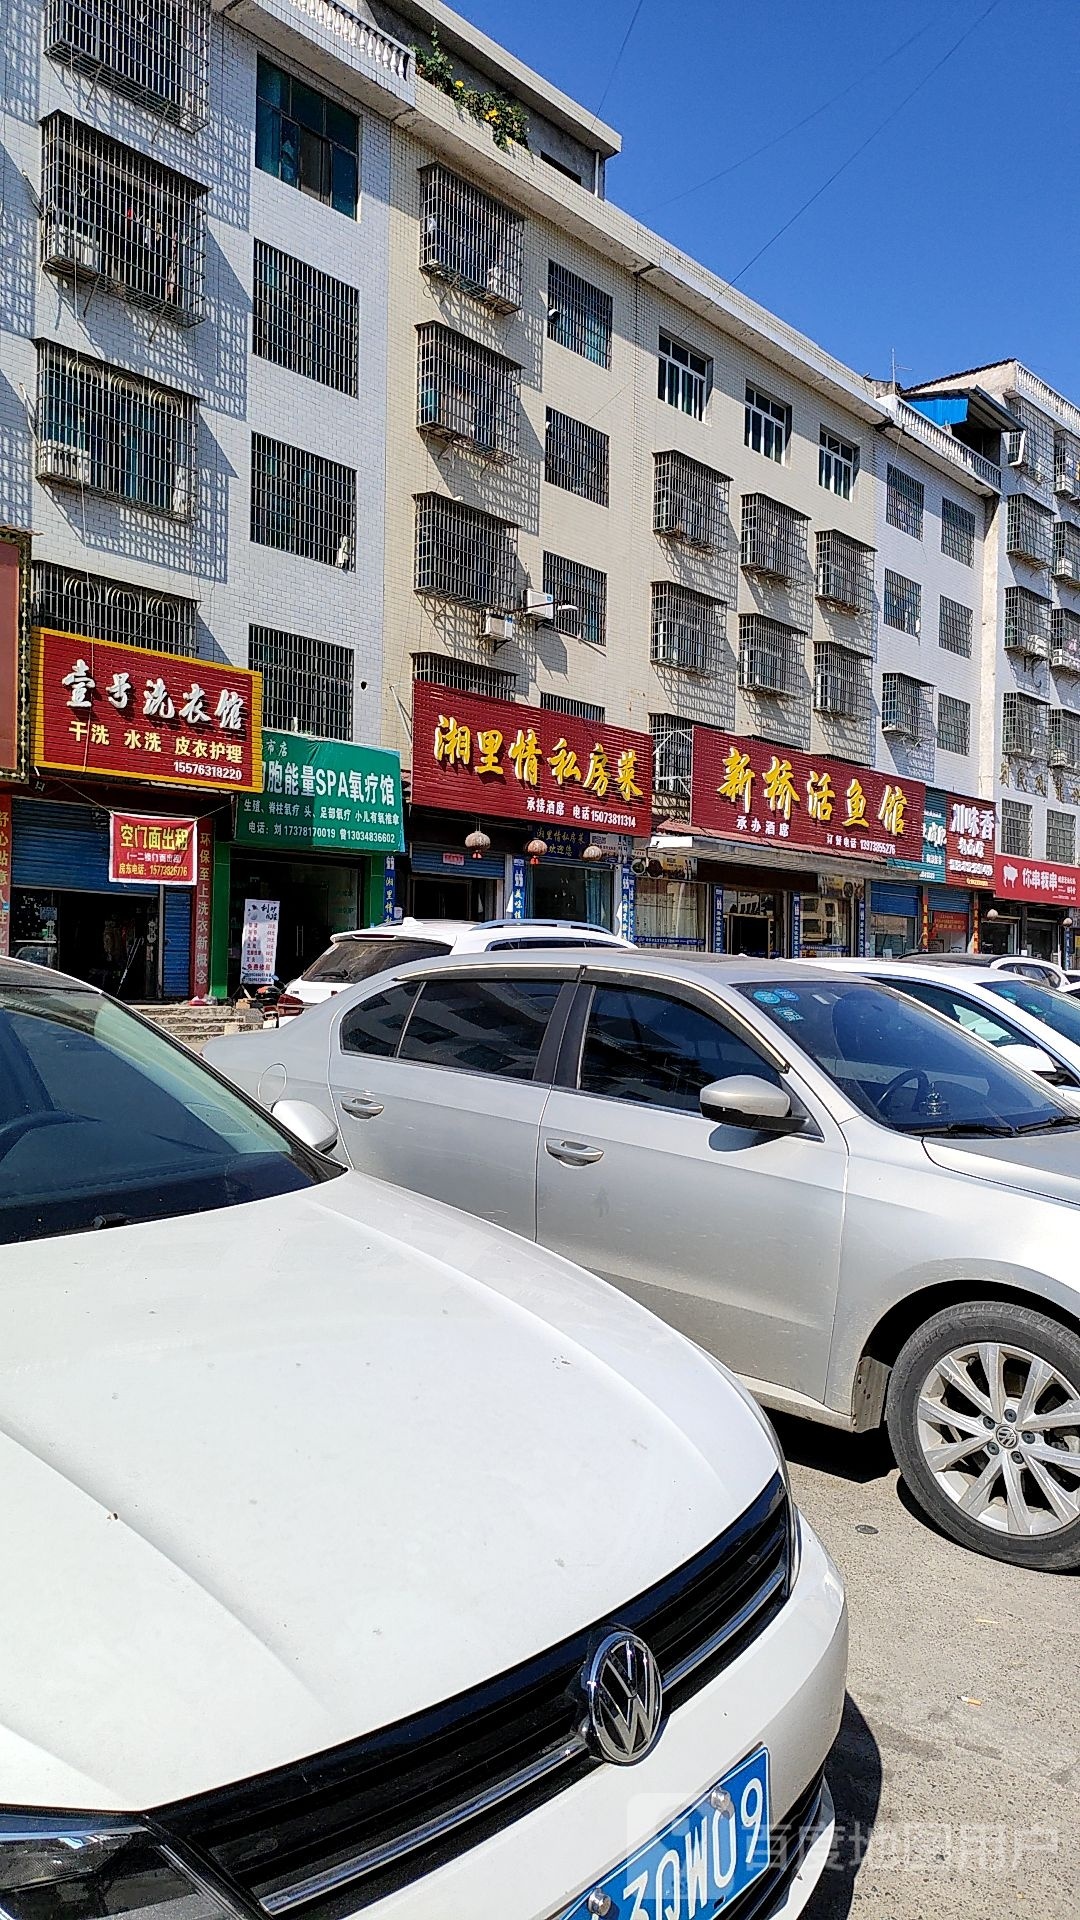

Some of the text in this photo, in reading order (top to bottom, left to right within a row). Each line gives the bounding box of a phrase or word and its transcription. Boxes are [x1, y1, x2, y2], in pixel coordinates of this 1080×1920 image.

[62, 659, 247, 730] 壹号洗衣馆
[69, 721, 243, 763] 干洗 水洗 皮衣护理
[262, 738, 288, 757] 市店
[433, 714, 643, 802] 湘里情私房菜
[173, 761, 242, 780] 15576318220
[526, 796, 565, 817] 承接酒席
[717, 747, 908, 836] 新桥活鱼馆
[120, 823, 189, 851] 空门面出租
[736, 815, 790, 838] 承办酒席
[620, 1777, 763, 1920] 3QW09
